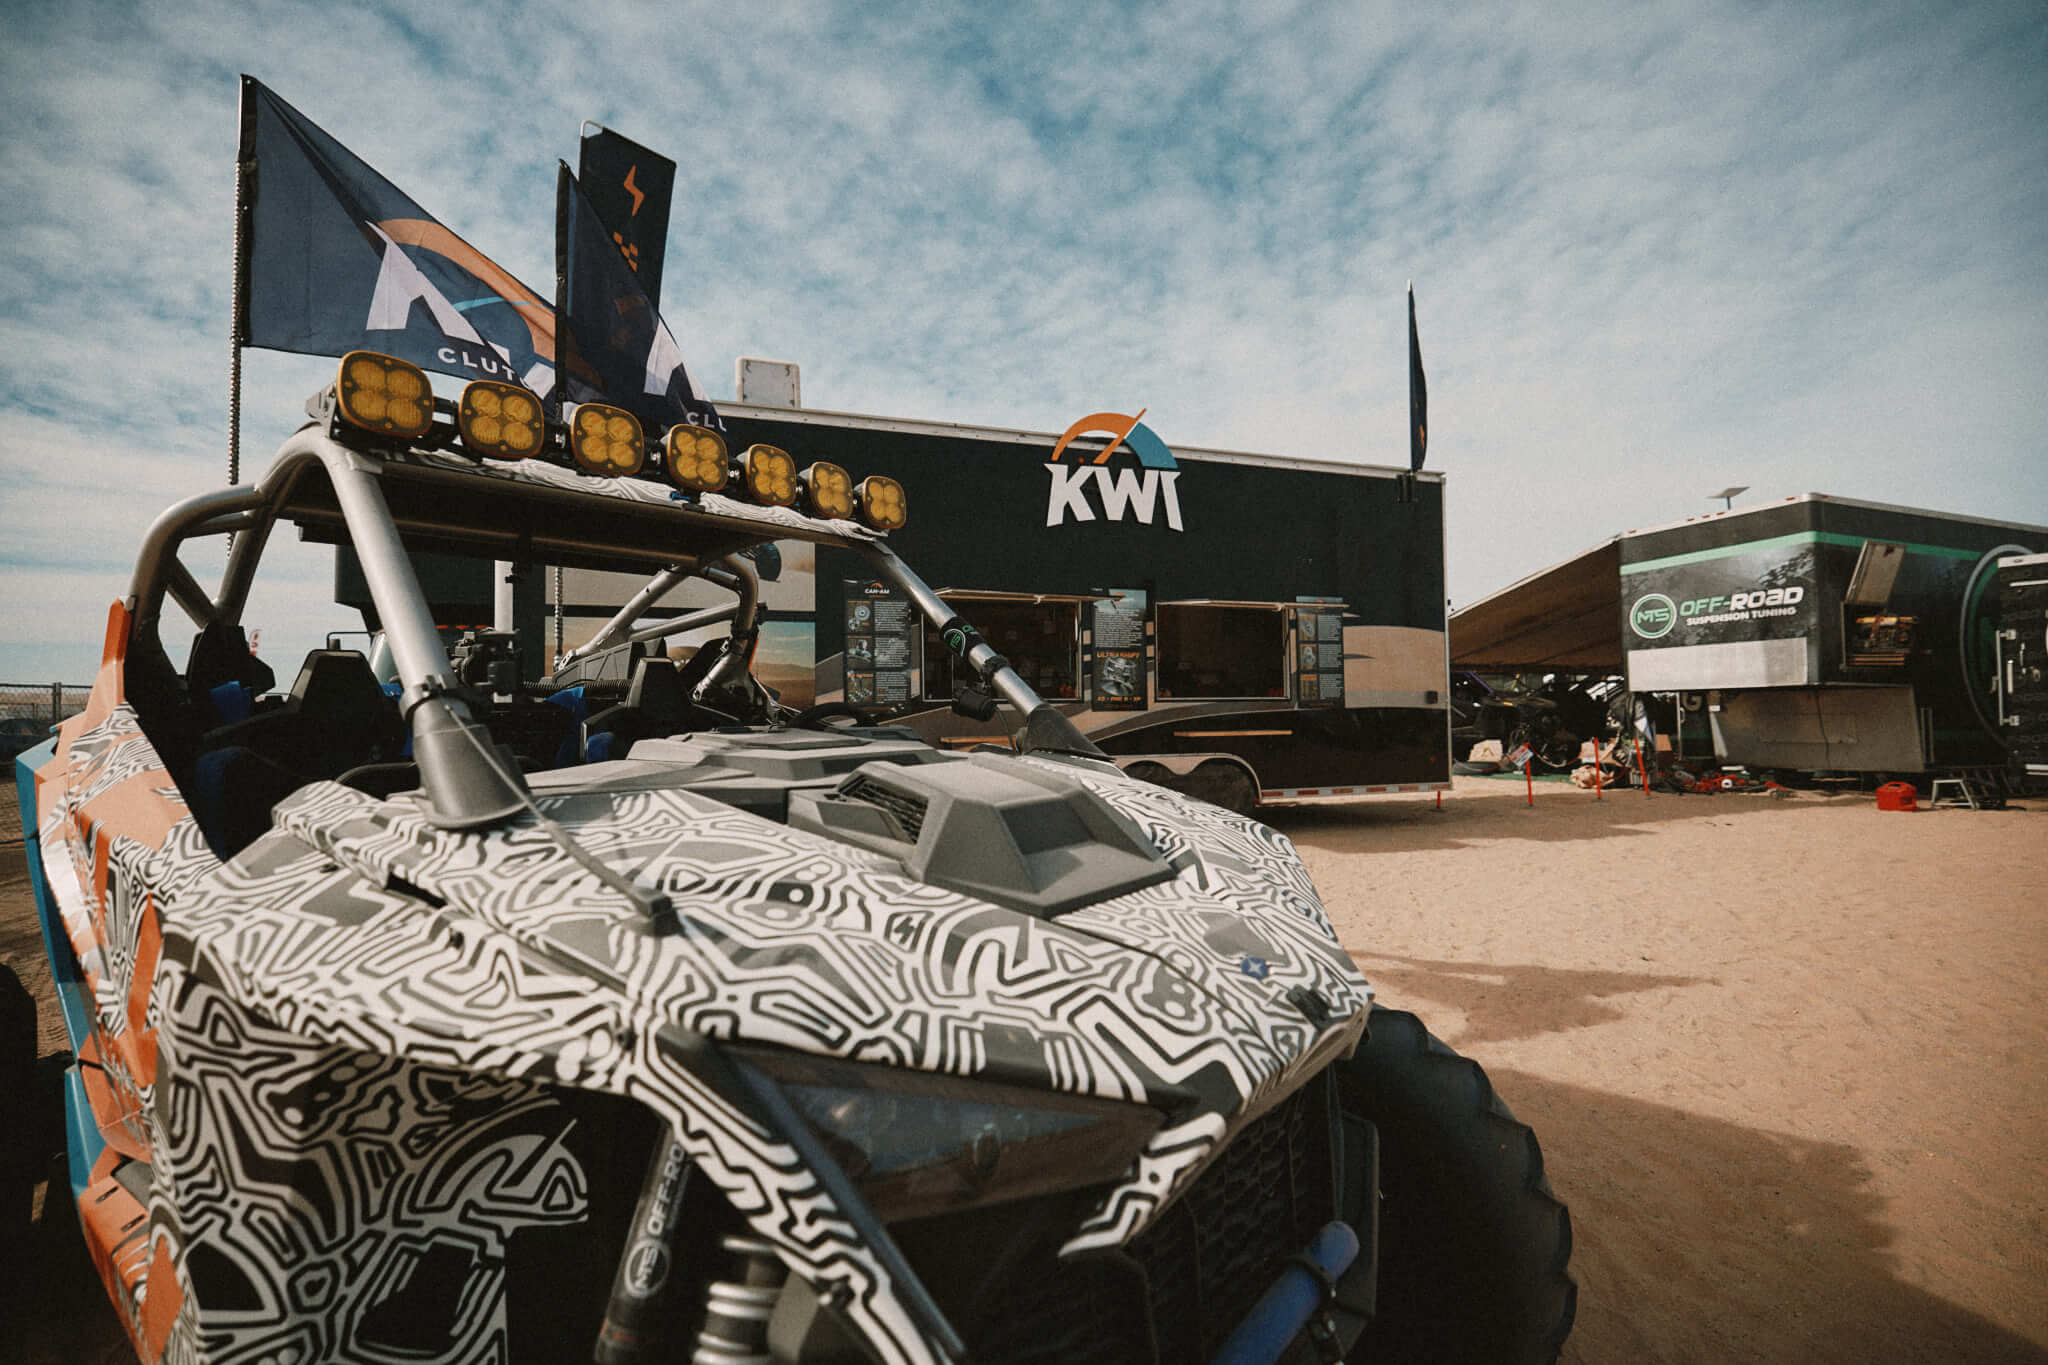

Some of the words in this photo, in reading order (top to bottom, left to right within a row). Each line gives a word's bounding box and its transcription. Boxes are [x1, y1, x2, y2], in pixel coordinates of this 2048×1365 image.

[1043, 463, 1185, 532] KWI
[1636, 607, 1670, 624] MTS
[1686, 612, 1750, 626] SUSPENSION
[1752, 607, 1797, 619] TUNING
